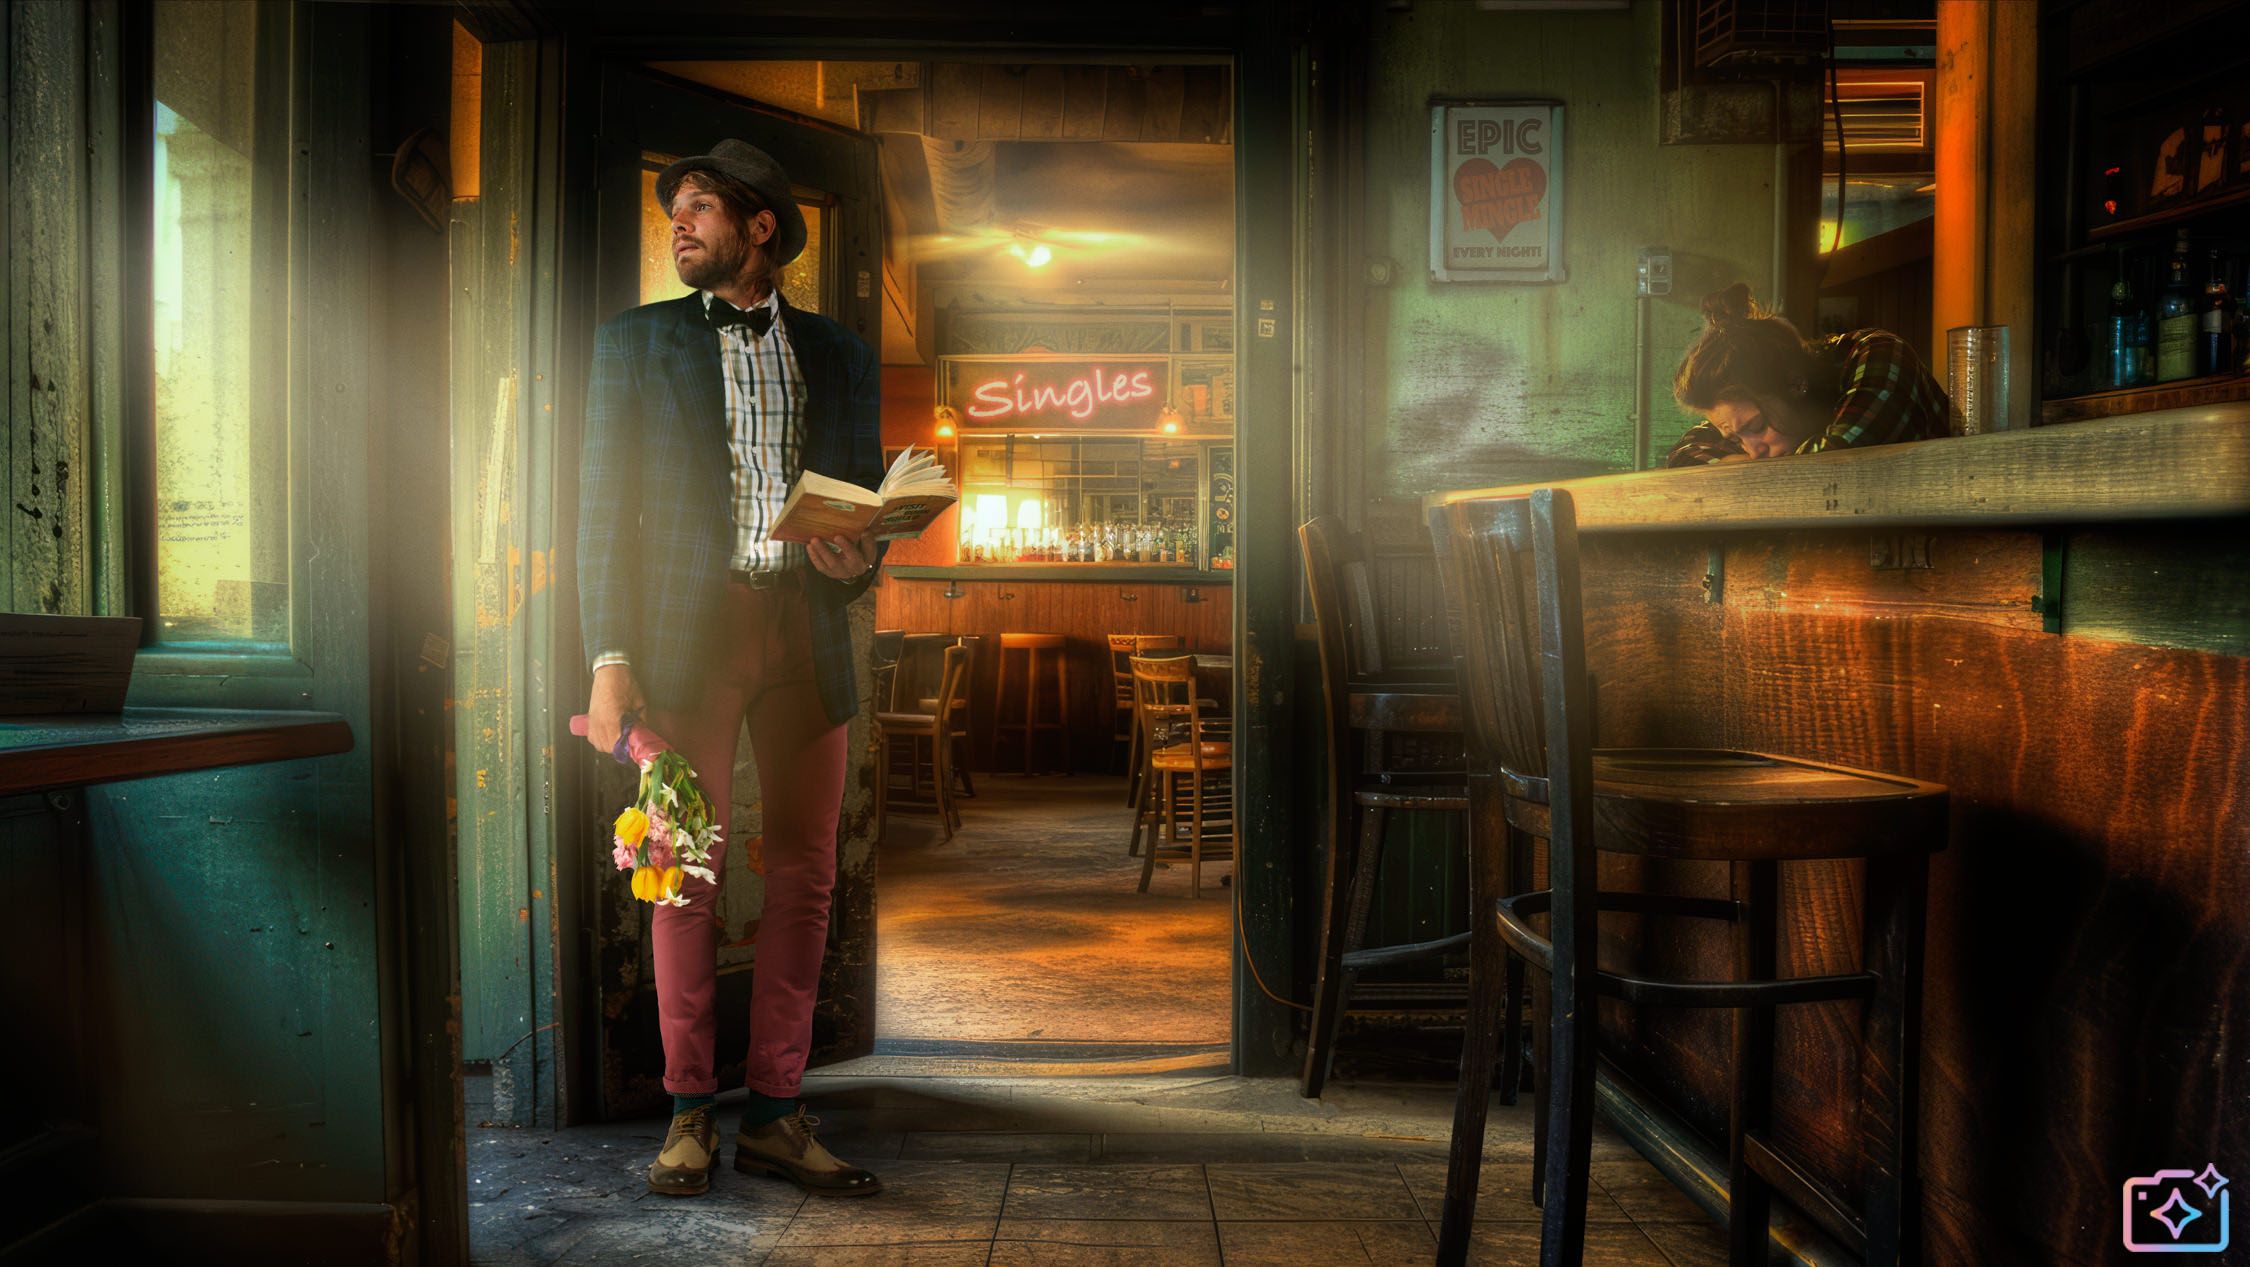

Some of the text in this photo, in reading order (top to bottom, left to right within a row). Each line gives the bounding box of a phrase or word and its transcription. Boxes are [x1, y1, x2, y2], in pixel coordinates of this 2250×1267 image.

[1457, 119, 1543, 156] EPIC
[1460, 167, 1533, 204] SINGLE
[1461, 193, 1542, 232] MINGLE
[1453, 246, 1542, 259] EVERY NIGHT!
[967, 368, 1154, 418] Singles
